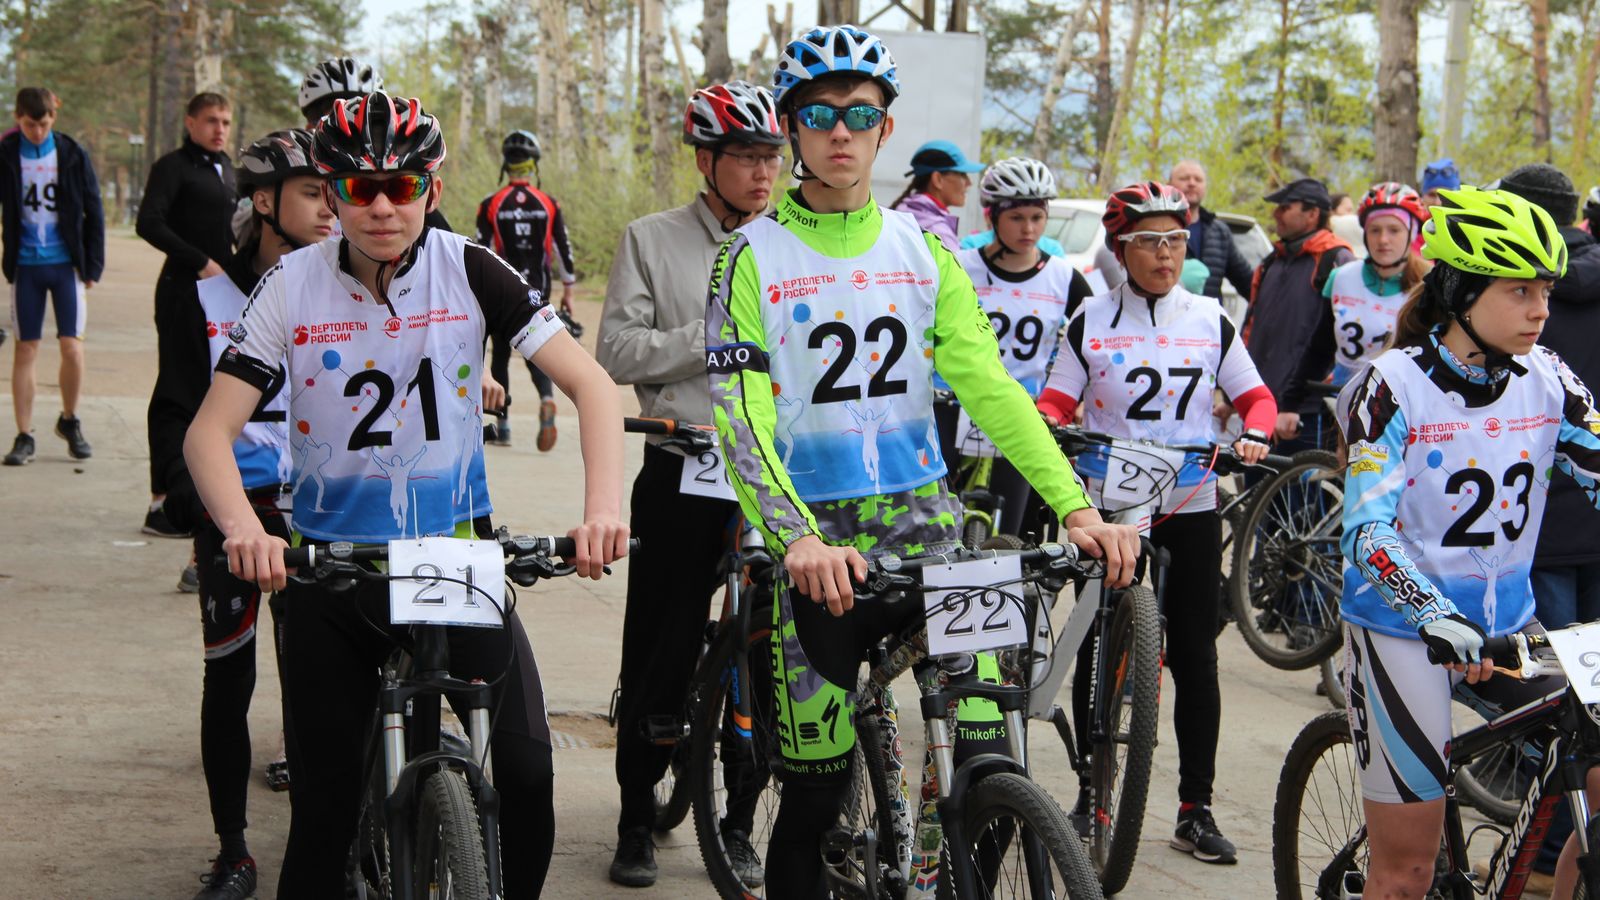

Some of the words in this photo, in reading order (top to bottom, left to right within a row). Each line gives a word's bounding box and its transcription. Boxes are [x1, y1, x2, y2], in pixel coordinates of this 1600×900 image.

[23, 183, 58, 212] 49
[782, 201, 819, 229] Tinkoff
[1453, 257, 1501, 273] RUDY
[310, 322, 368, 335] ВЕРТОЛЕТЫ
[310, 332, 352, 344] РОССИИ
[808, 316, 907, 404] 22
[344, 358, 440, 451] 21
[1125, 367, 1202, 420] 27
[694, 451, 731, 487] 2
[1117, 461, 1168, 494] 27
[1441, 461, 1534, 547] 23
[411, 563, 480, 608] 21
[942, 590, 1011, 637] 22
[1089, 635, 1100, 709] manitou
[783, 759, 848, 774] nkoff-SAXO
[1502, 795, 1561, 900] ERIDA
